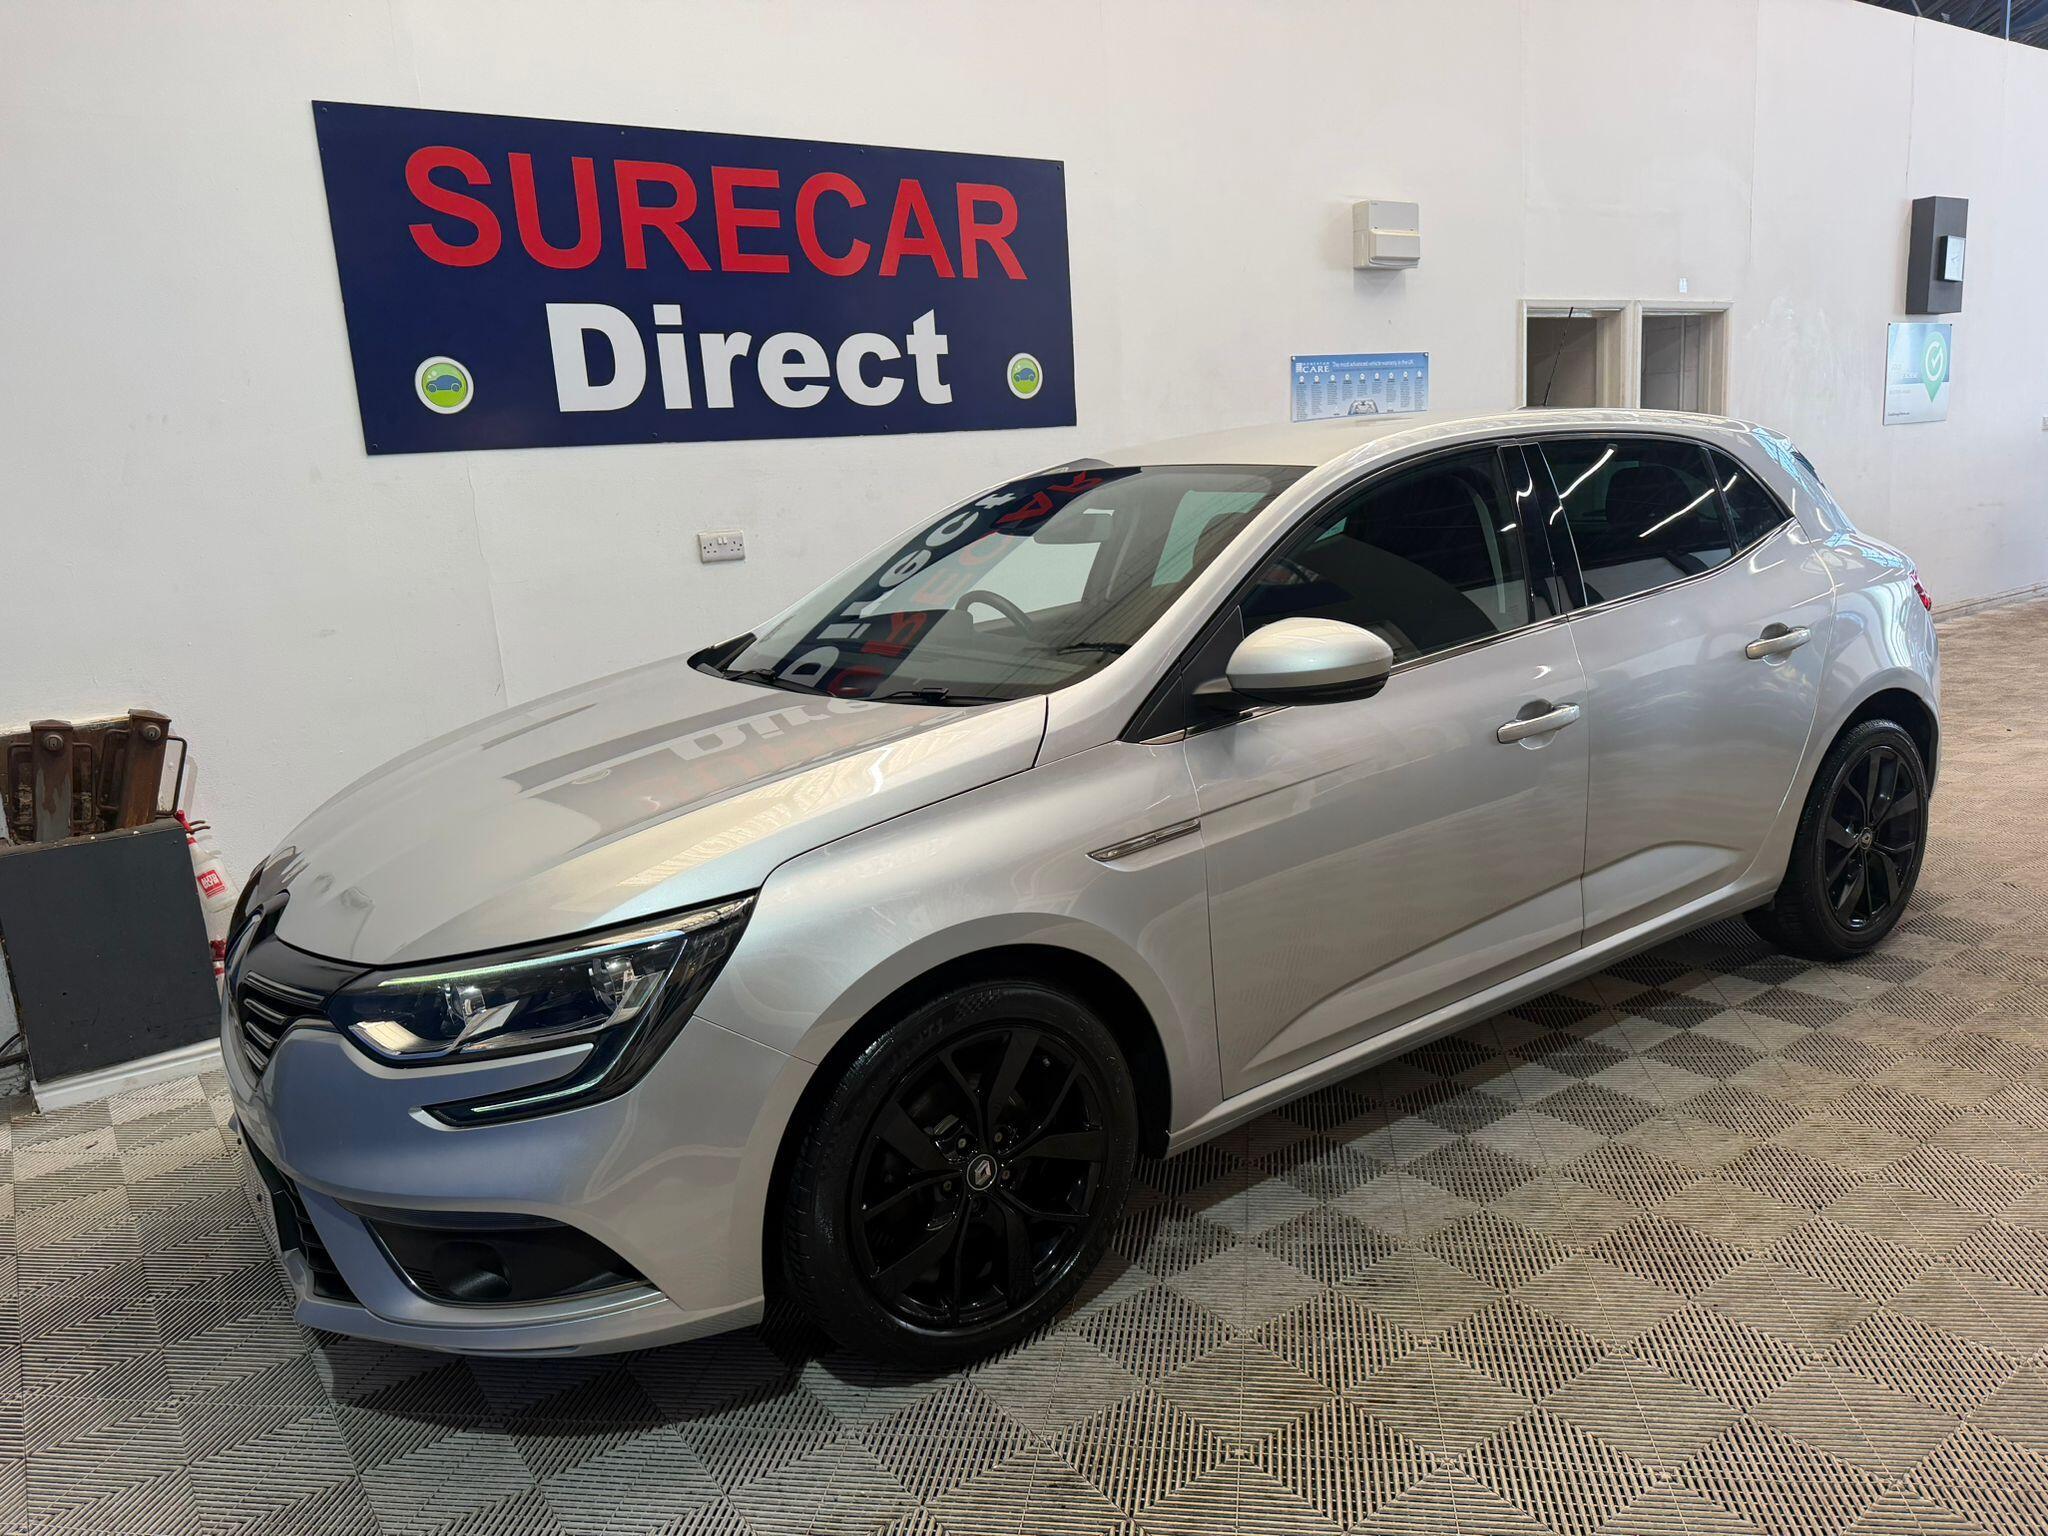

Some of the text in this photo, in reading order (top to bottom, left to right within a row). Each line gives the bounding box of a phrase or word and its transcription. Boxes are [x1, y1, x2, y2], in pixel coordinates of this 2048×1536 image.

[405, 146, 1028, 280] SURECAR
[545, 303, 953, 412] Direct
[1303, 365, 1330, 374] CARE
